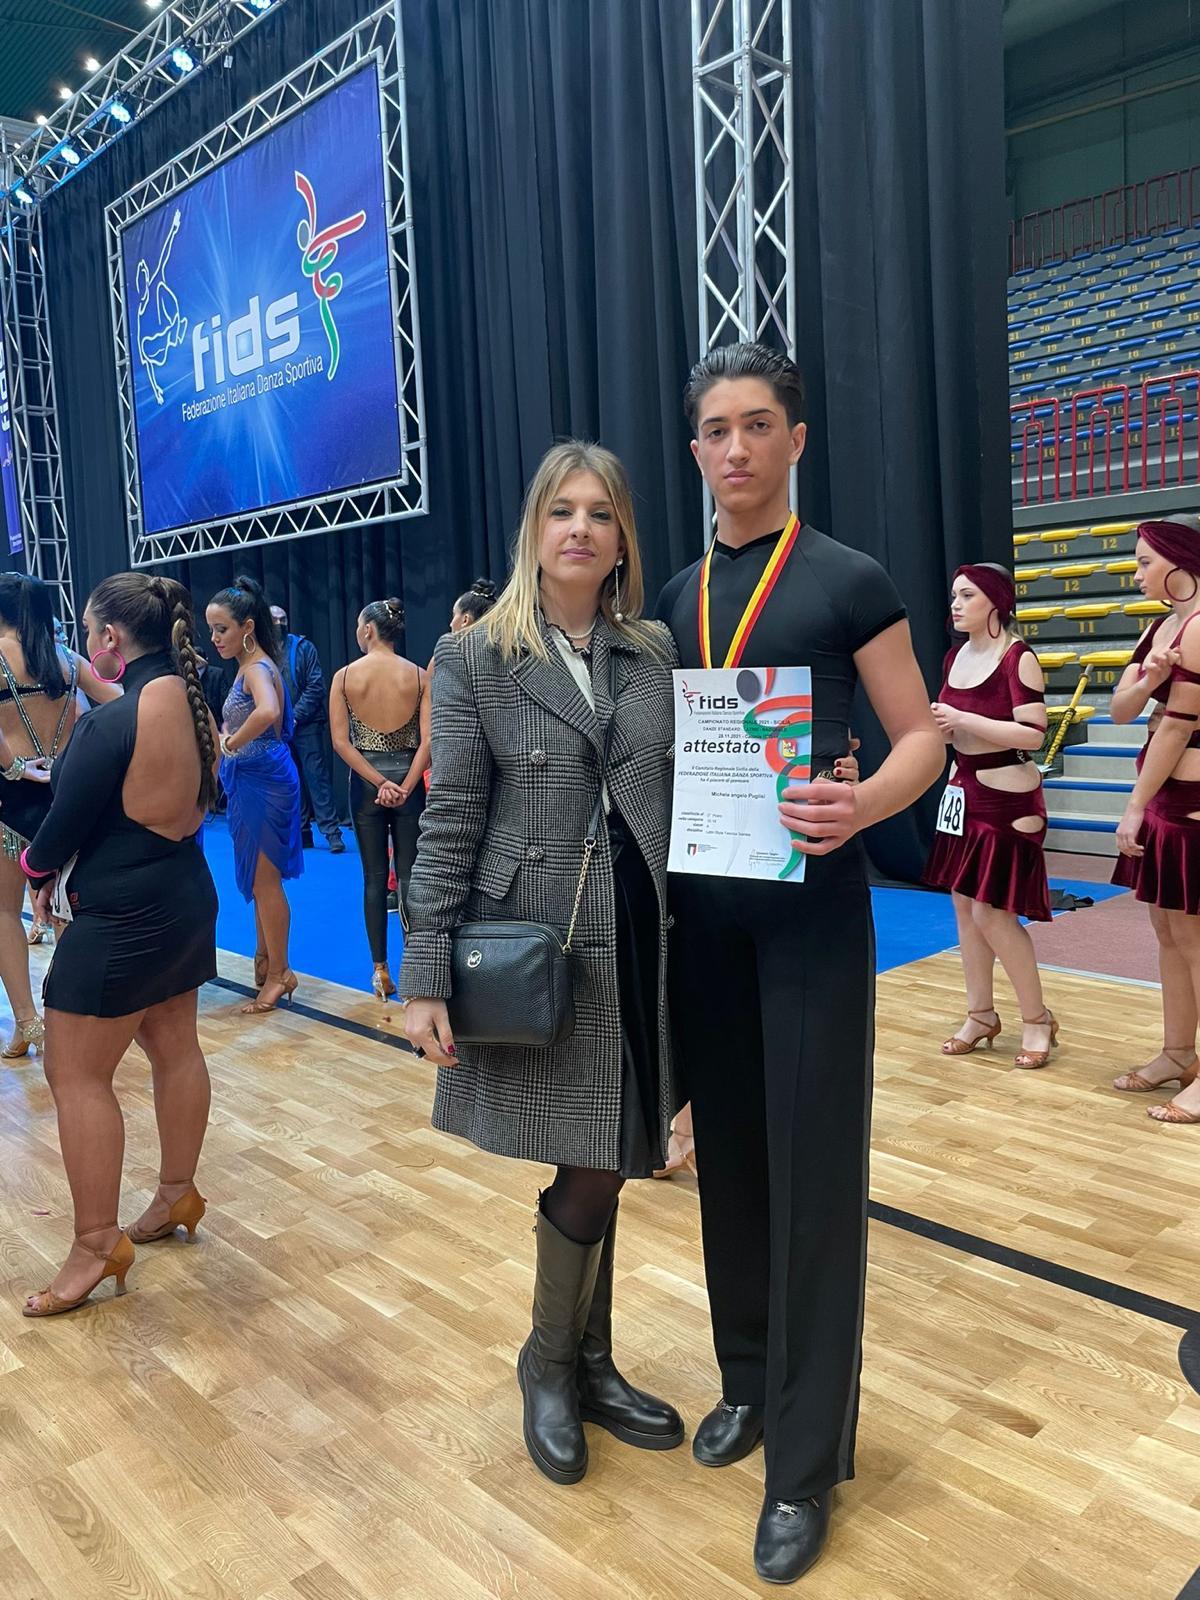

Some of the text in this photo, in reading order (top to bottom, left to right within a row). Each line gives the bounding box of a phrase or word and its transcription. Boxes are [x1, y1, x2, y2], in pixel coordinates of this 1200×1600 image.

[1115, 328, 1126, 338] 17
[192, 291, 300, 392] fids
[181, 354, 324, 422] Federazione Italiana Danza Sportiva
[1052, 543, 1068, 555] 13
[1102, 538, 1118, 550] 12
[1064, 580, 1080, 592] 12
[1023, 624, 1039, 636] 12
[1079, 621, 1095, 633] 11
[1096, 671, 1116, 684] 10
[700, 696, 738, 709] fids
[683, 740, 761, 754] attestato
[939, 793, 962, 831] 148
